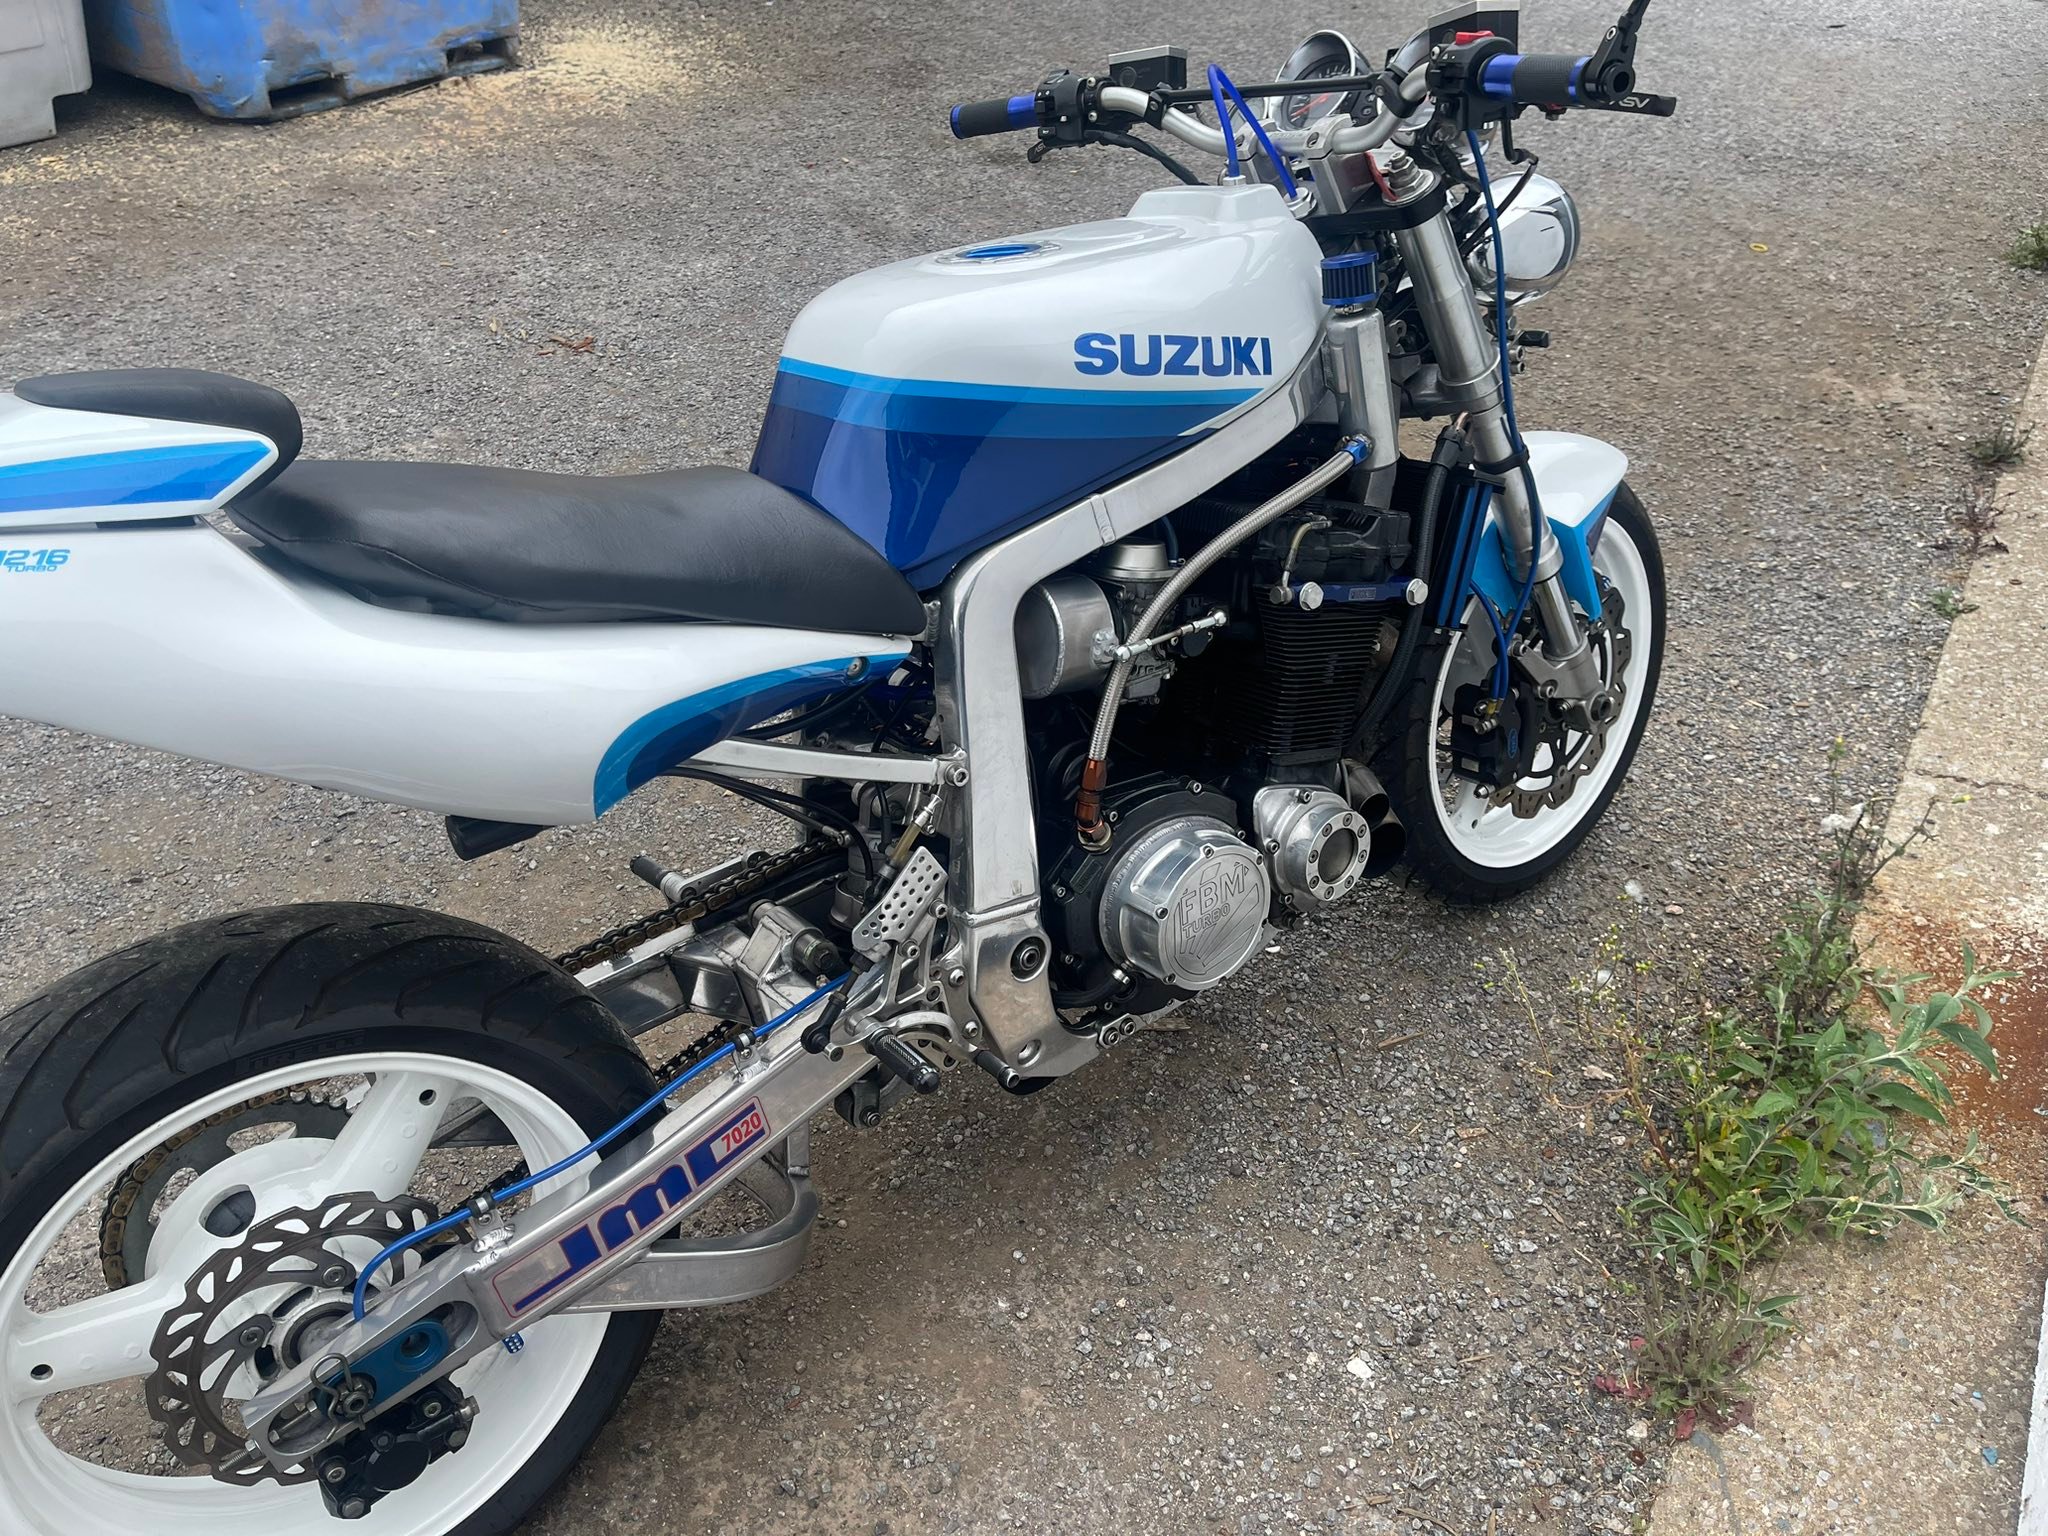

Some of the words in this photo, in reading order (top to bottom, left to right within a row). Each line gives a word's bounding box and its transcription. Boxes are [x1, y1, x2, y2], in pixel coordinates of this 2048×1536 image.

[1074, 332, 1272, 376] SUZUKI
[7, 565, 57, 573] TURBO
[1181, 864, 1244, 926] FBM
[1183, 902, 1231, 938] TURBO
[721, 1112, 762, 1152] 7020
